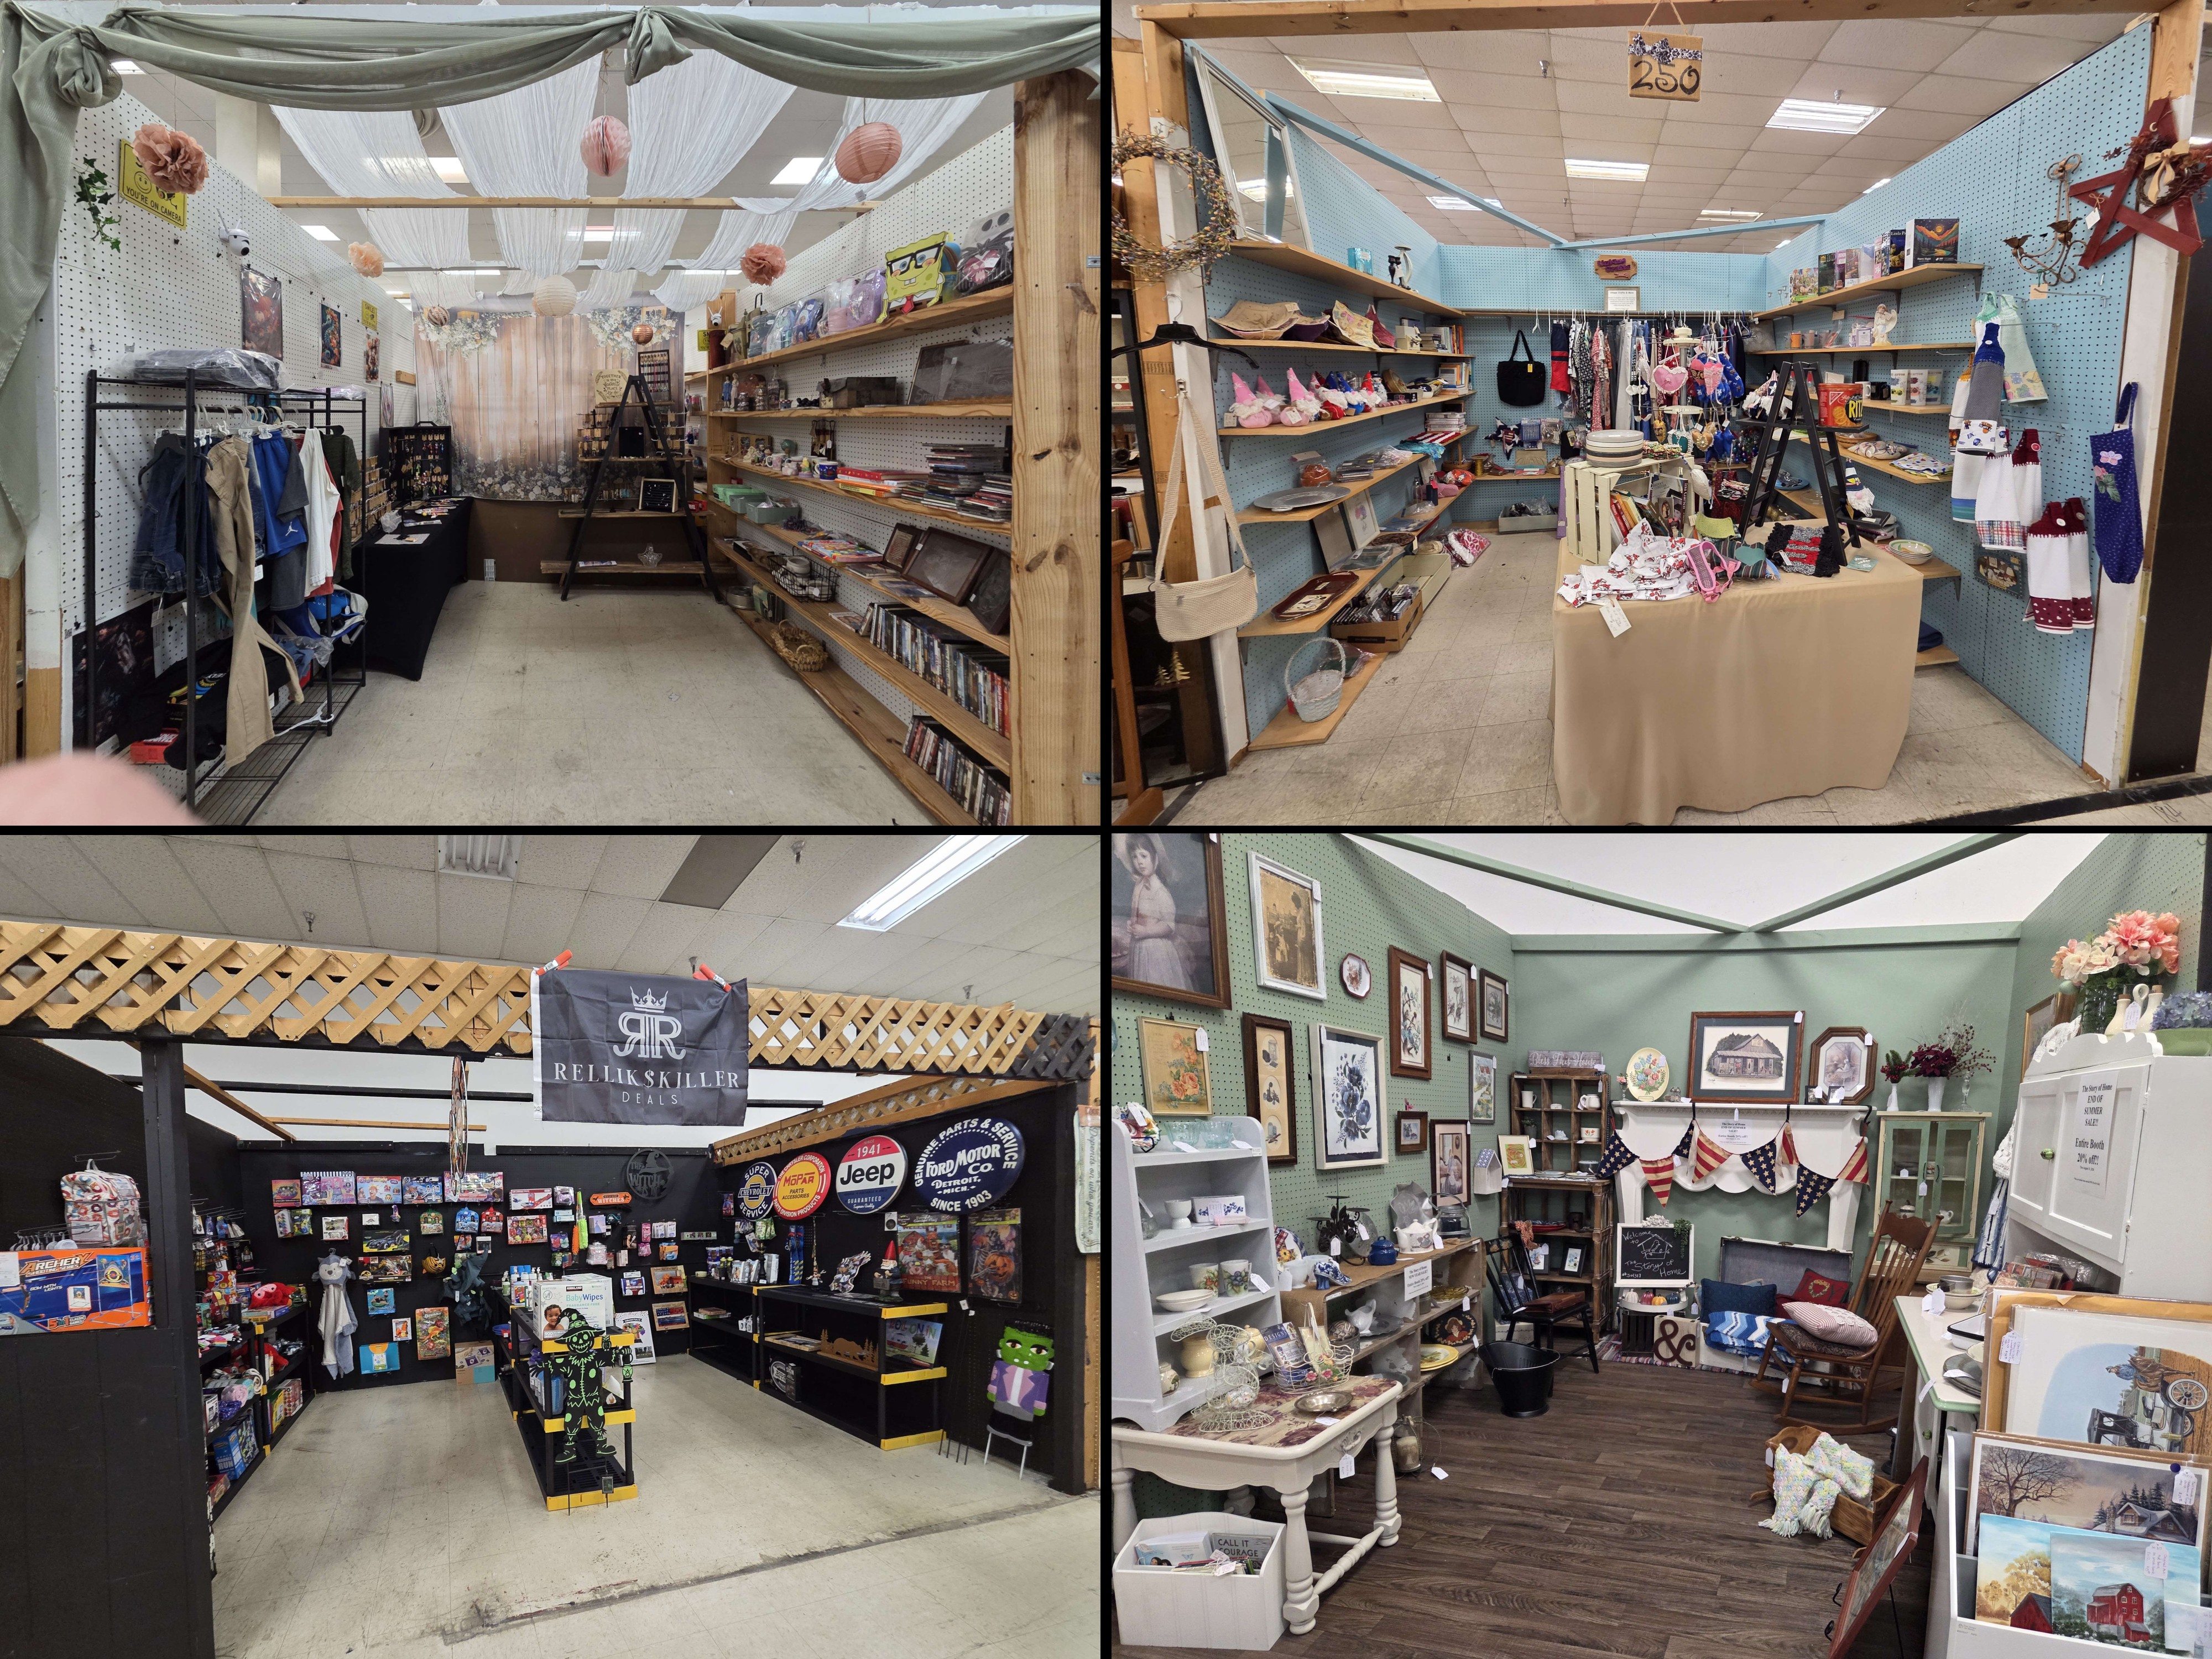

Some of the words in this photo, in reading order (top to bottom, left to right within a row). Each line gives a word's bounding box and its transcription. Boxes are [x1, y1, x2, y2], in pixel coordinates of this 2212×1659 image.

[1631, 60, 1700, 95] 250
[127, 186, 148, 205] YOU'RE
[150, 200, 159, 211] ON
[161, 206, 181, 222] CAMERA
[1529, 1052, 1551, 1066] Bless
[1553, 1051, 1571, 1066] This
[1572, 1051, 1597, 1067] House
[554, 1062, 739, 1089] RELLIK$KILLER
[2089, 1084, 2098, 1093] Story
[622, 1091, 678, 1105] DEALS
[857, 1144, 880, 1157] 1941
[1087, 1126, 1099, 1164] Depends
[2075, 1138, 2089, 1149] Entire
[2090, 1139, 2104, 1150] Booth
[915, 1139, 939, 1187] GENUINE
[939, 1118, 979, 1140] PARTS
[980, 1118, 992, 1128] &
[991, 1122, 1019, 1168] SERVICE
[2077, 1153, 2088, 1164] 20%
[778, 1169, 786, 1180] THE
[784, 1155, 804, 1172] CHRYSLER
[804, 1155, 825, 1173] CORPORATION
[925, 1159, 954, 1177] FORD
[947, 1144, 1001, 1177] MOTOR
[744, 1166, 769, 1181] SUPER
[840, 1162, 895, 1186] Jeep
[968, 1163, 994, 1175] CO.
[1089, 1168, 1094, 1179] on
[628, 1173, 661, 1188] WITCH
[740, 1187, 770, 1196] CHEVROLET
[780, 1209, 797, 1217] DIVISION
[797, 1194, 821, 1215] PRODUCTS
[930, 1197, 961, 1211] SINCE
[965, 1190, 992, 1209] 1903
[739, 1201, 768, 1218] SERVICE
[1623, 1230, 1652, 1240] Welcome
[21, 1253, 93, 1275] ARCHERY
[1631, 1261, 1663, 1271] Story
[28, 1268, 59, 1276] SHOOTING
[1660, 1267, 1686, 1277] Home
[910, 1323, 925, 1334] ON
[925, 1324, 937, 1339] IN
[1264, 1331, 1287, 1341] DESIGNS
[1655, 1318, 1696, 1366] &
[218, 1462, 234, 1470] RUN
